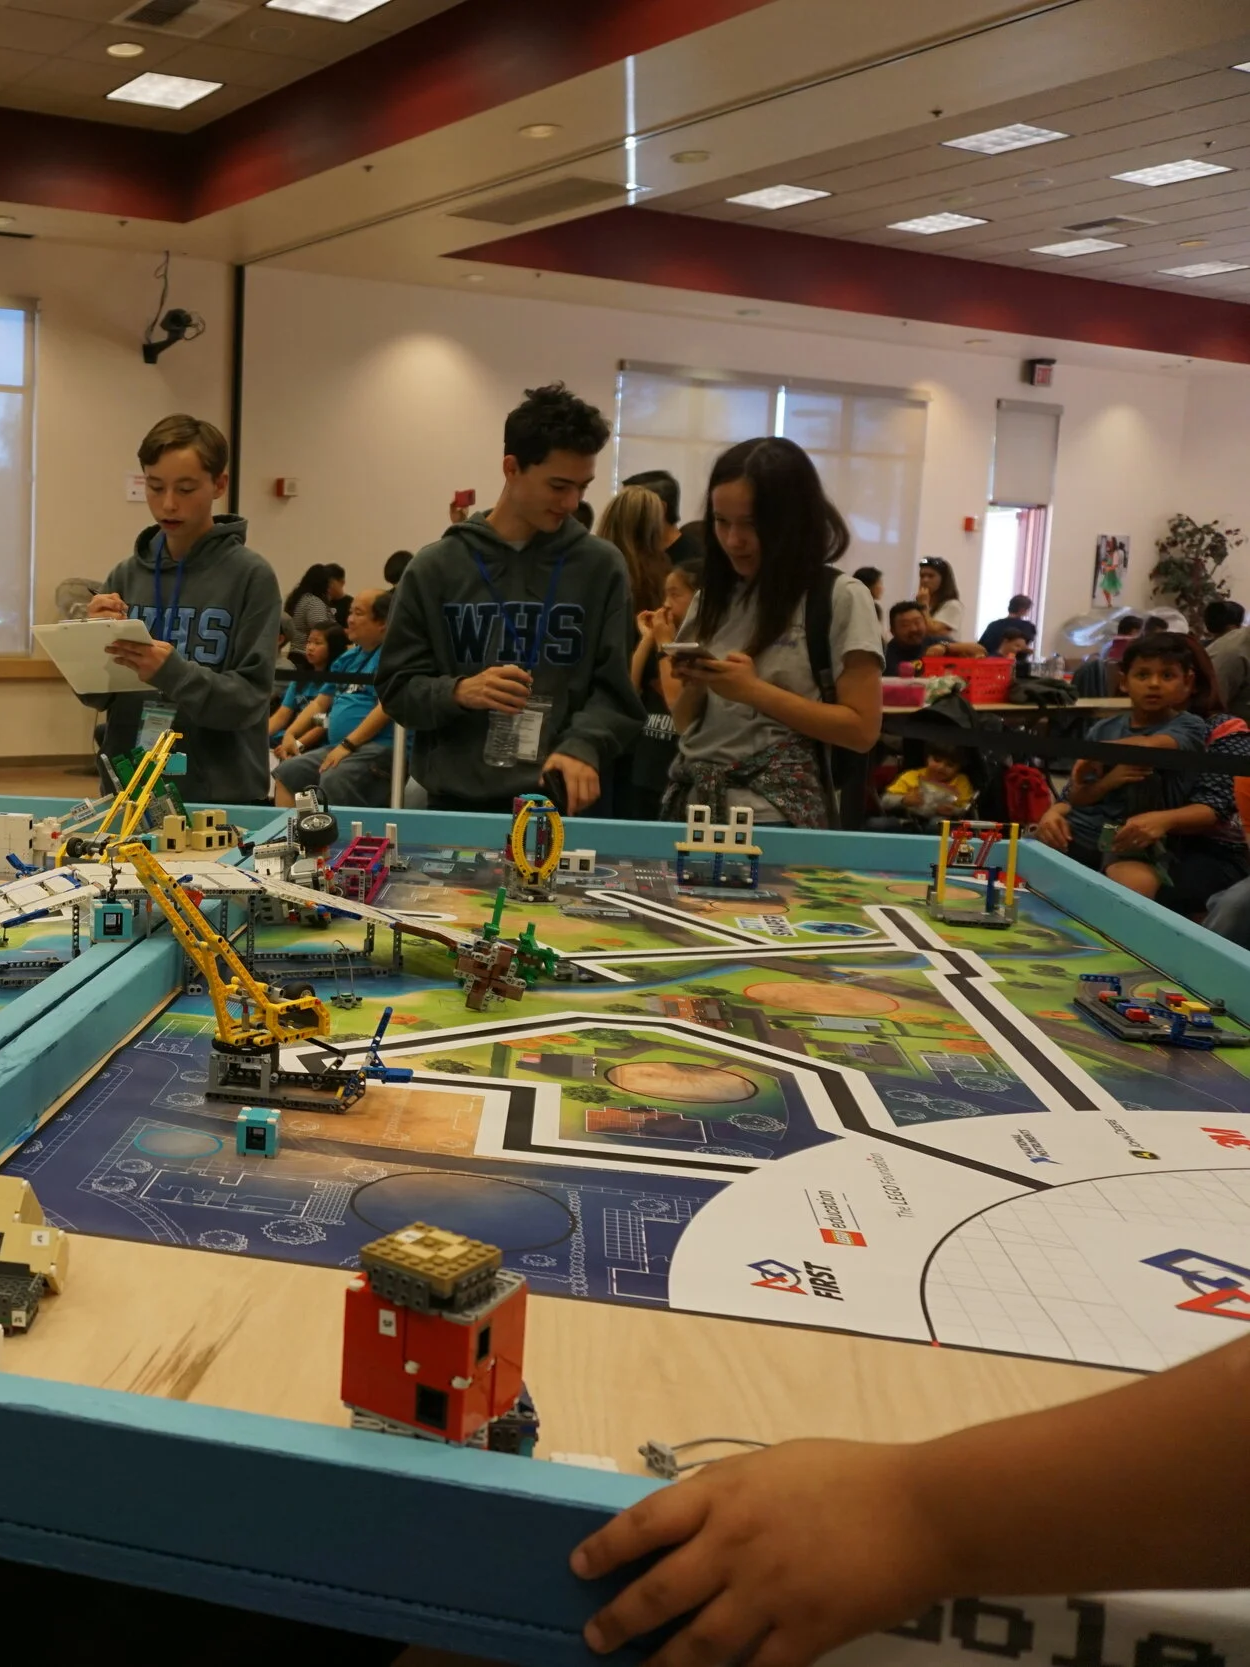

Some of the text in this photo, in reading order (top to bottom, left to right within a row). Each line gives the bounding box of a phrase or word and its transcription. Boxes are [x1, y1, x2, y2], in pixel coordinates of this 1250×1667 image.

[442, 601, 586, 666] WHS
[816, 1189, 847, 1229] education
[866, 1152, 914, 1219] The LEGO Foundation
[803, 1260, 845, 1302] FIRST
